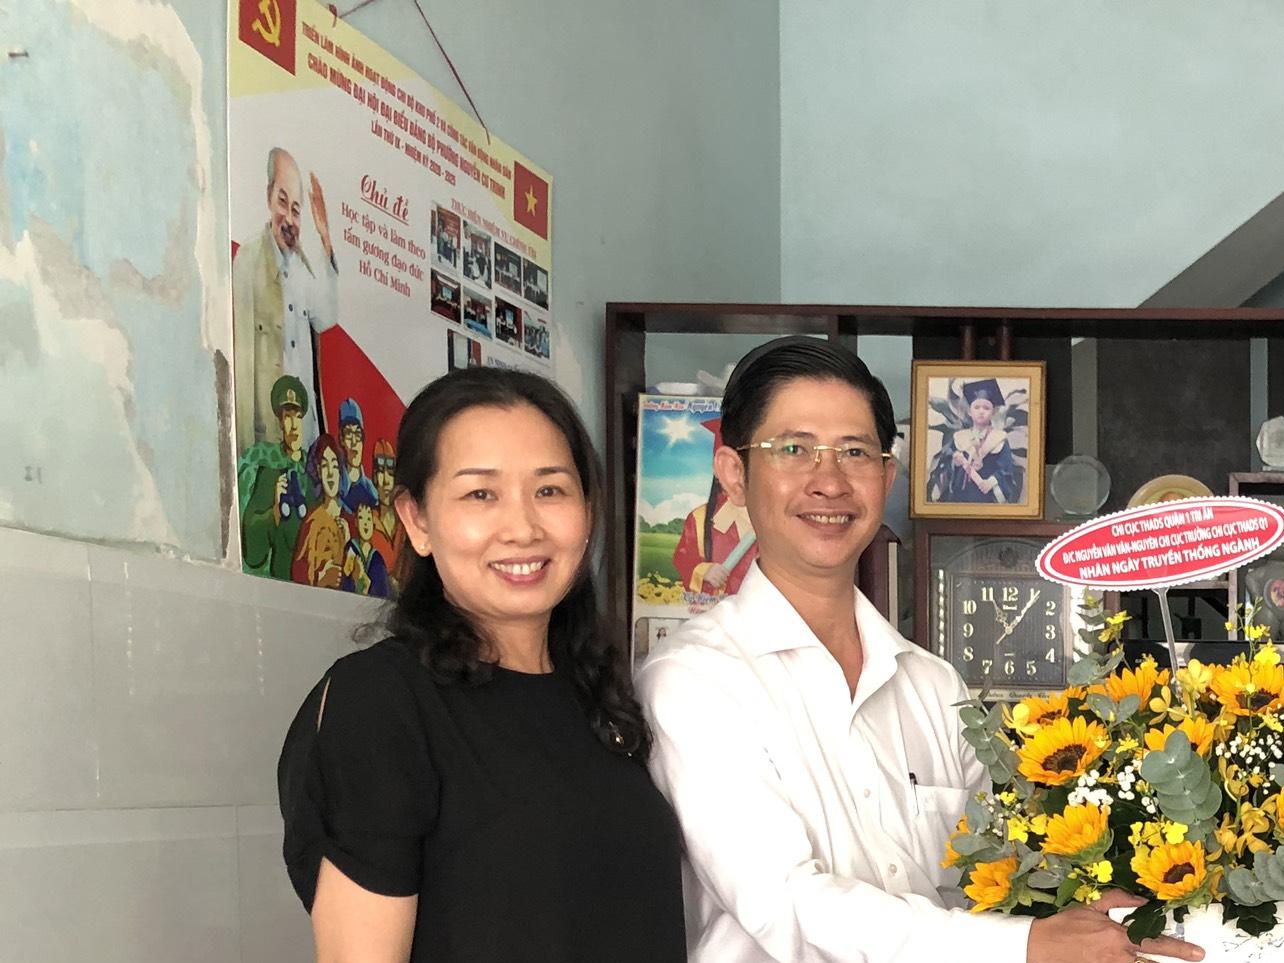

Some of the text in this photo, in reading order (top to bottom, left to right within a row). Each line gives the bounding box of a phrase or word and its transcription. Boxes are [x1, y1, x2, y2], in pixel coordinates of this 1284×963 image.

[361, 174, 389, 210] Chủ
[341, 202, 426, 260] Học tập và làm theo
[344, 226, 424, 281] tấm gương đạo đức
[359, 259, 411, 297] Hồ Chí Minh
[1111, 524, 1124, 537] CHI
[1125, 521, 1140, 537] CỤC
[1140, 517, 1163, 532] THADS
[1164, 511, 1185, 529] QUẬN
[1190, 509, 1201, 523] TRI
[1159, 534, 1171, 548] CHI
[1171, 532, 1184, 548] CỤC
[1211, 526, 1223, 539] CHI
[1223, 523, 1237, 538] CỤC
[1236, 518, 1259, 534] THADS
[1258, 517, 1269, 532] Q1
[1079, 562, 1111, 580] NHÂN
[1111, 558, 1141, 574] NGÀY
[1221, 537, 1260, 556] NGÀNH
[981, 587, 994, 602] 11
[1002, 586, 1019, 602] 12
[962, 600, 977, 615] 10
[1045, 601, 1056, 616] 2
[963, 623, 974, 638] 9
[1045, 625, 1056, 640] 3
[962, 647, 974, 662] 8
[1045, 648, 1056, 663] 4
[982, 659, 993, 675] 7
[1004, 660, 1015, 675] 6
[1026, 660, 1037, 676] 5
